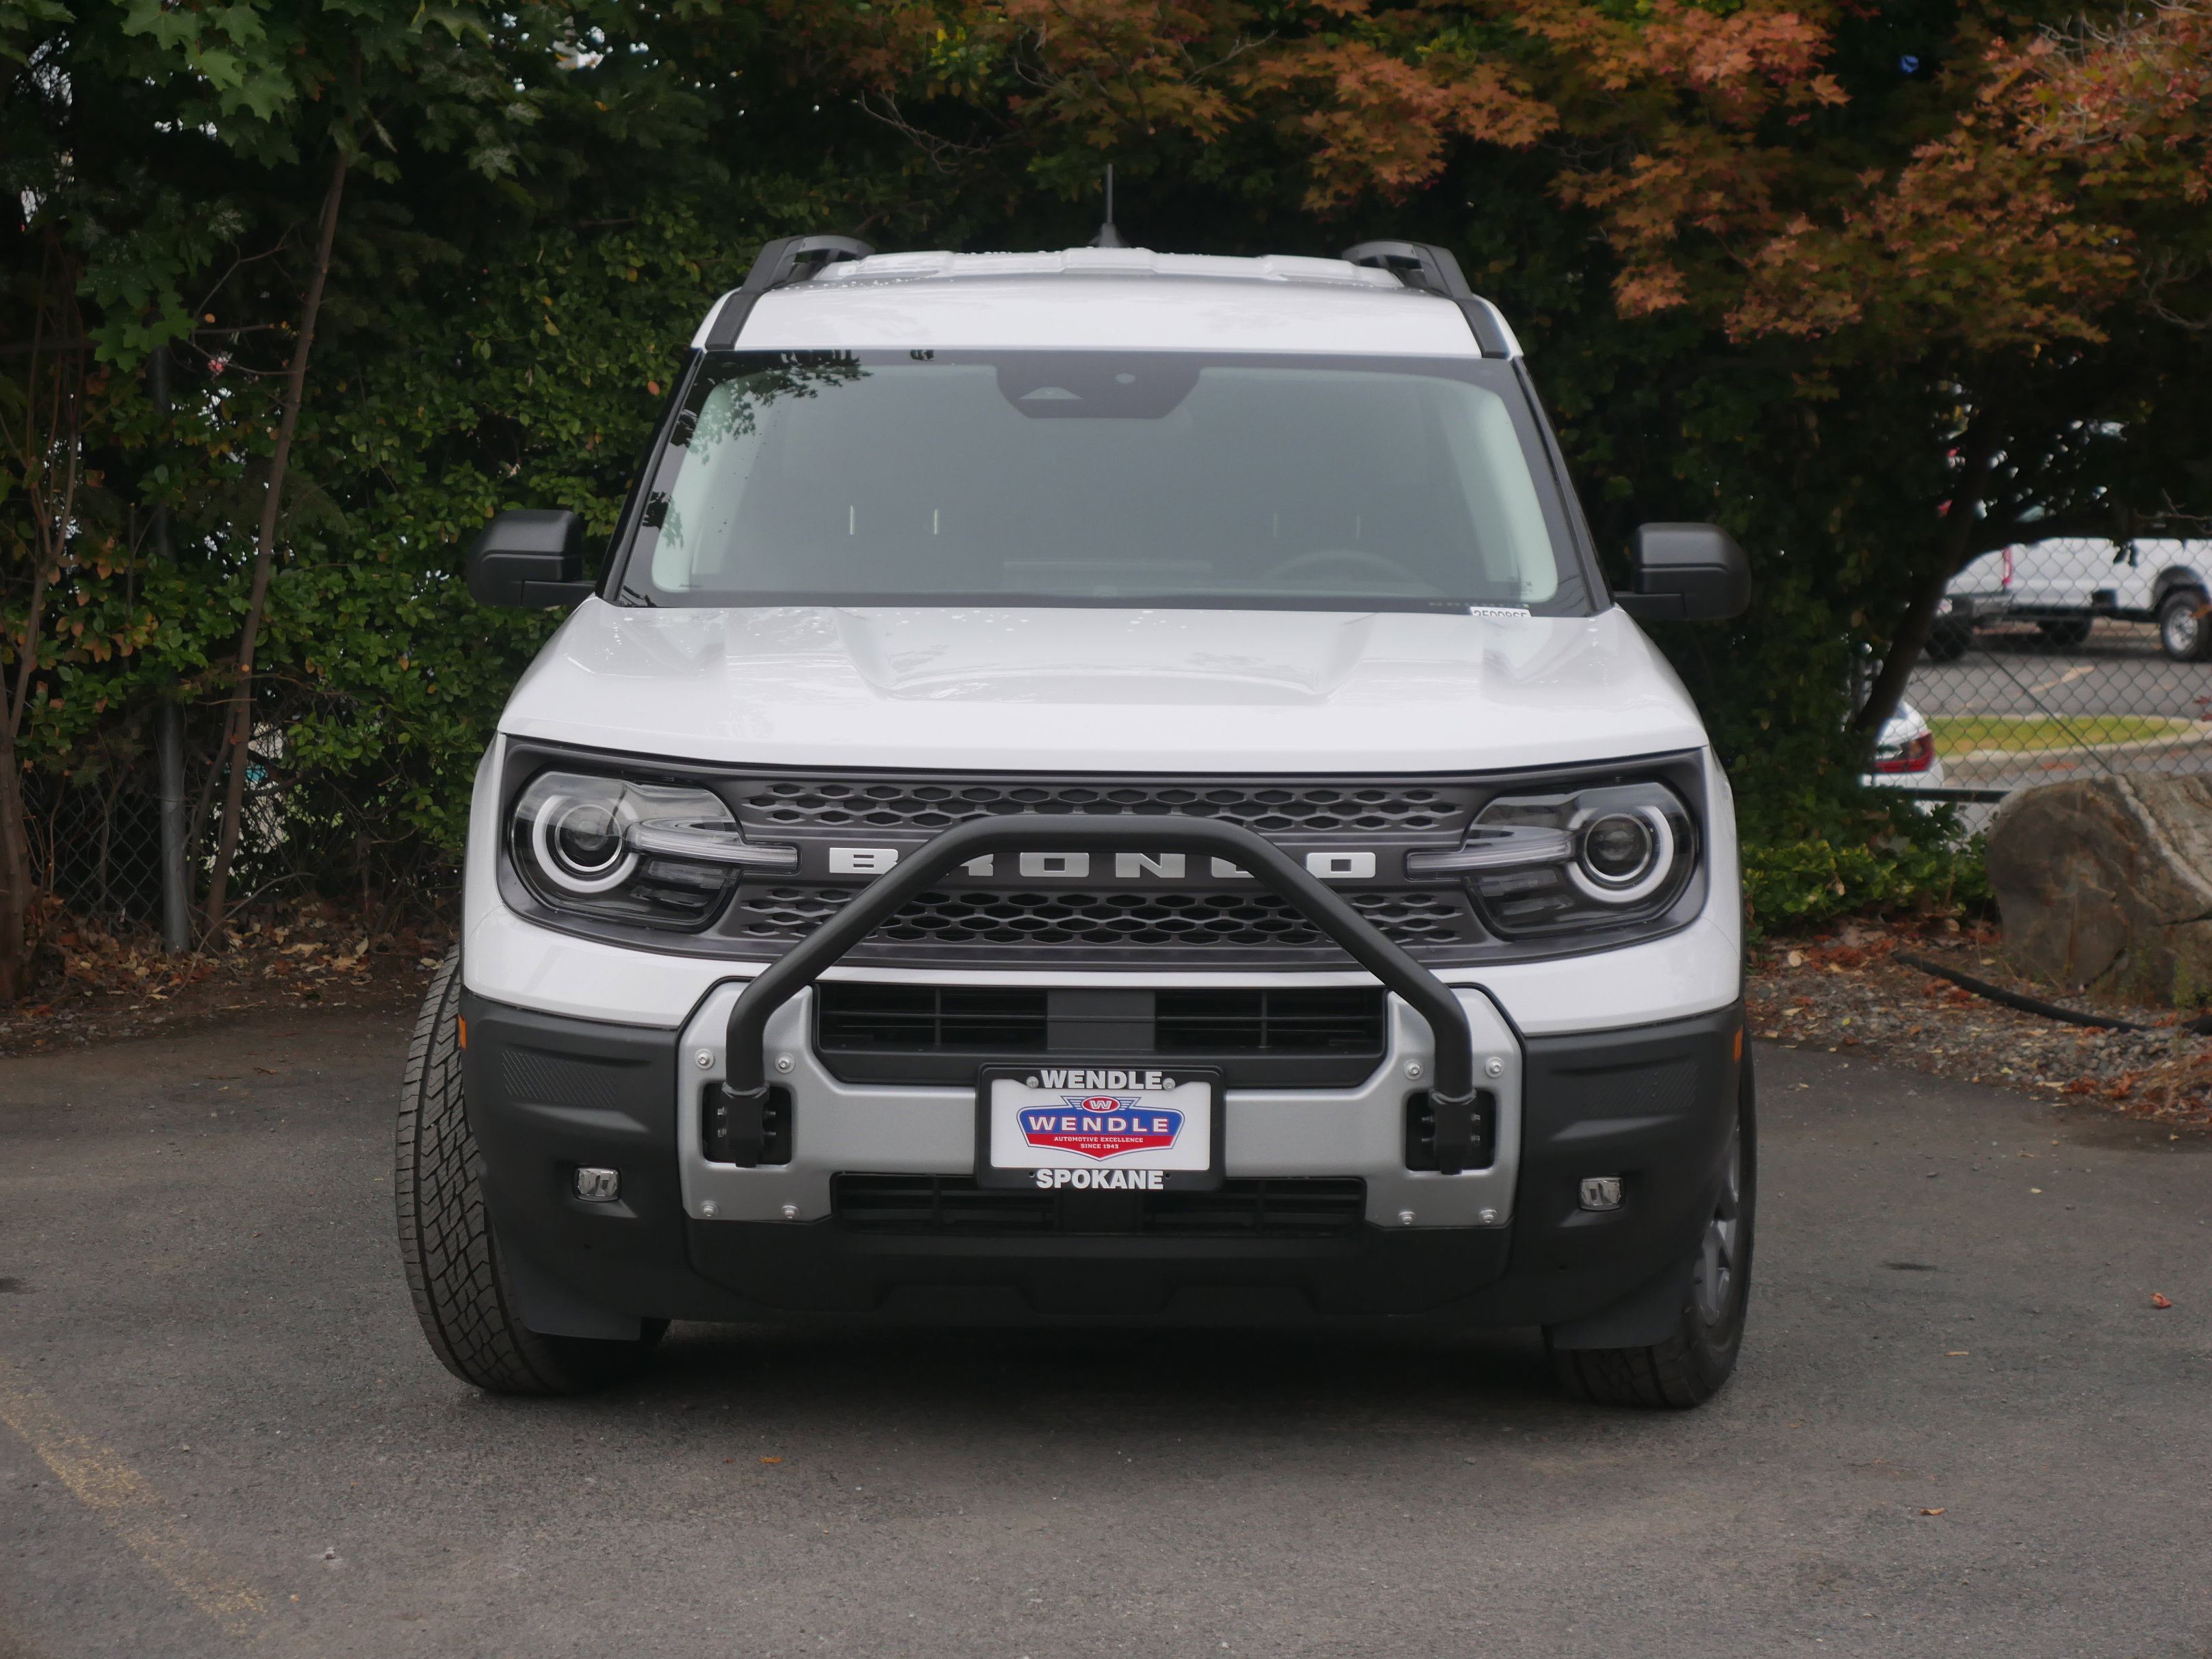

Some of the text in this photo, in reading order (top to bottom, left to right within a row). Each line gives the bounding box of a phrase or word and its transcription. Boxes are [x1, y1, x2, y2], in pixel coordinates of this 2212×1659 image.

[1041, 1070, 1163, 1090] WENDLE
[1029, 1116, 1169, 1133] WENDLE
[1036, 1168, 1163, 1190] SPOKANE
